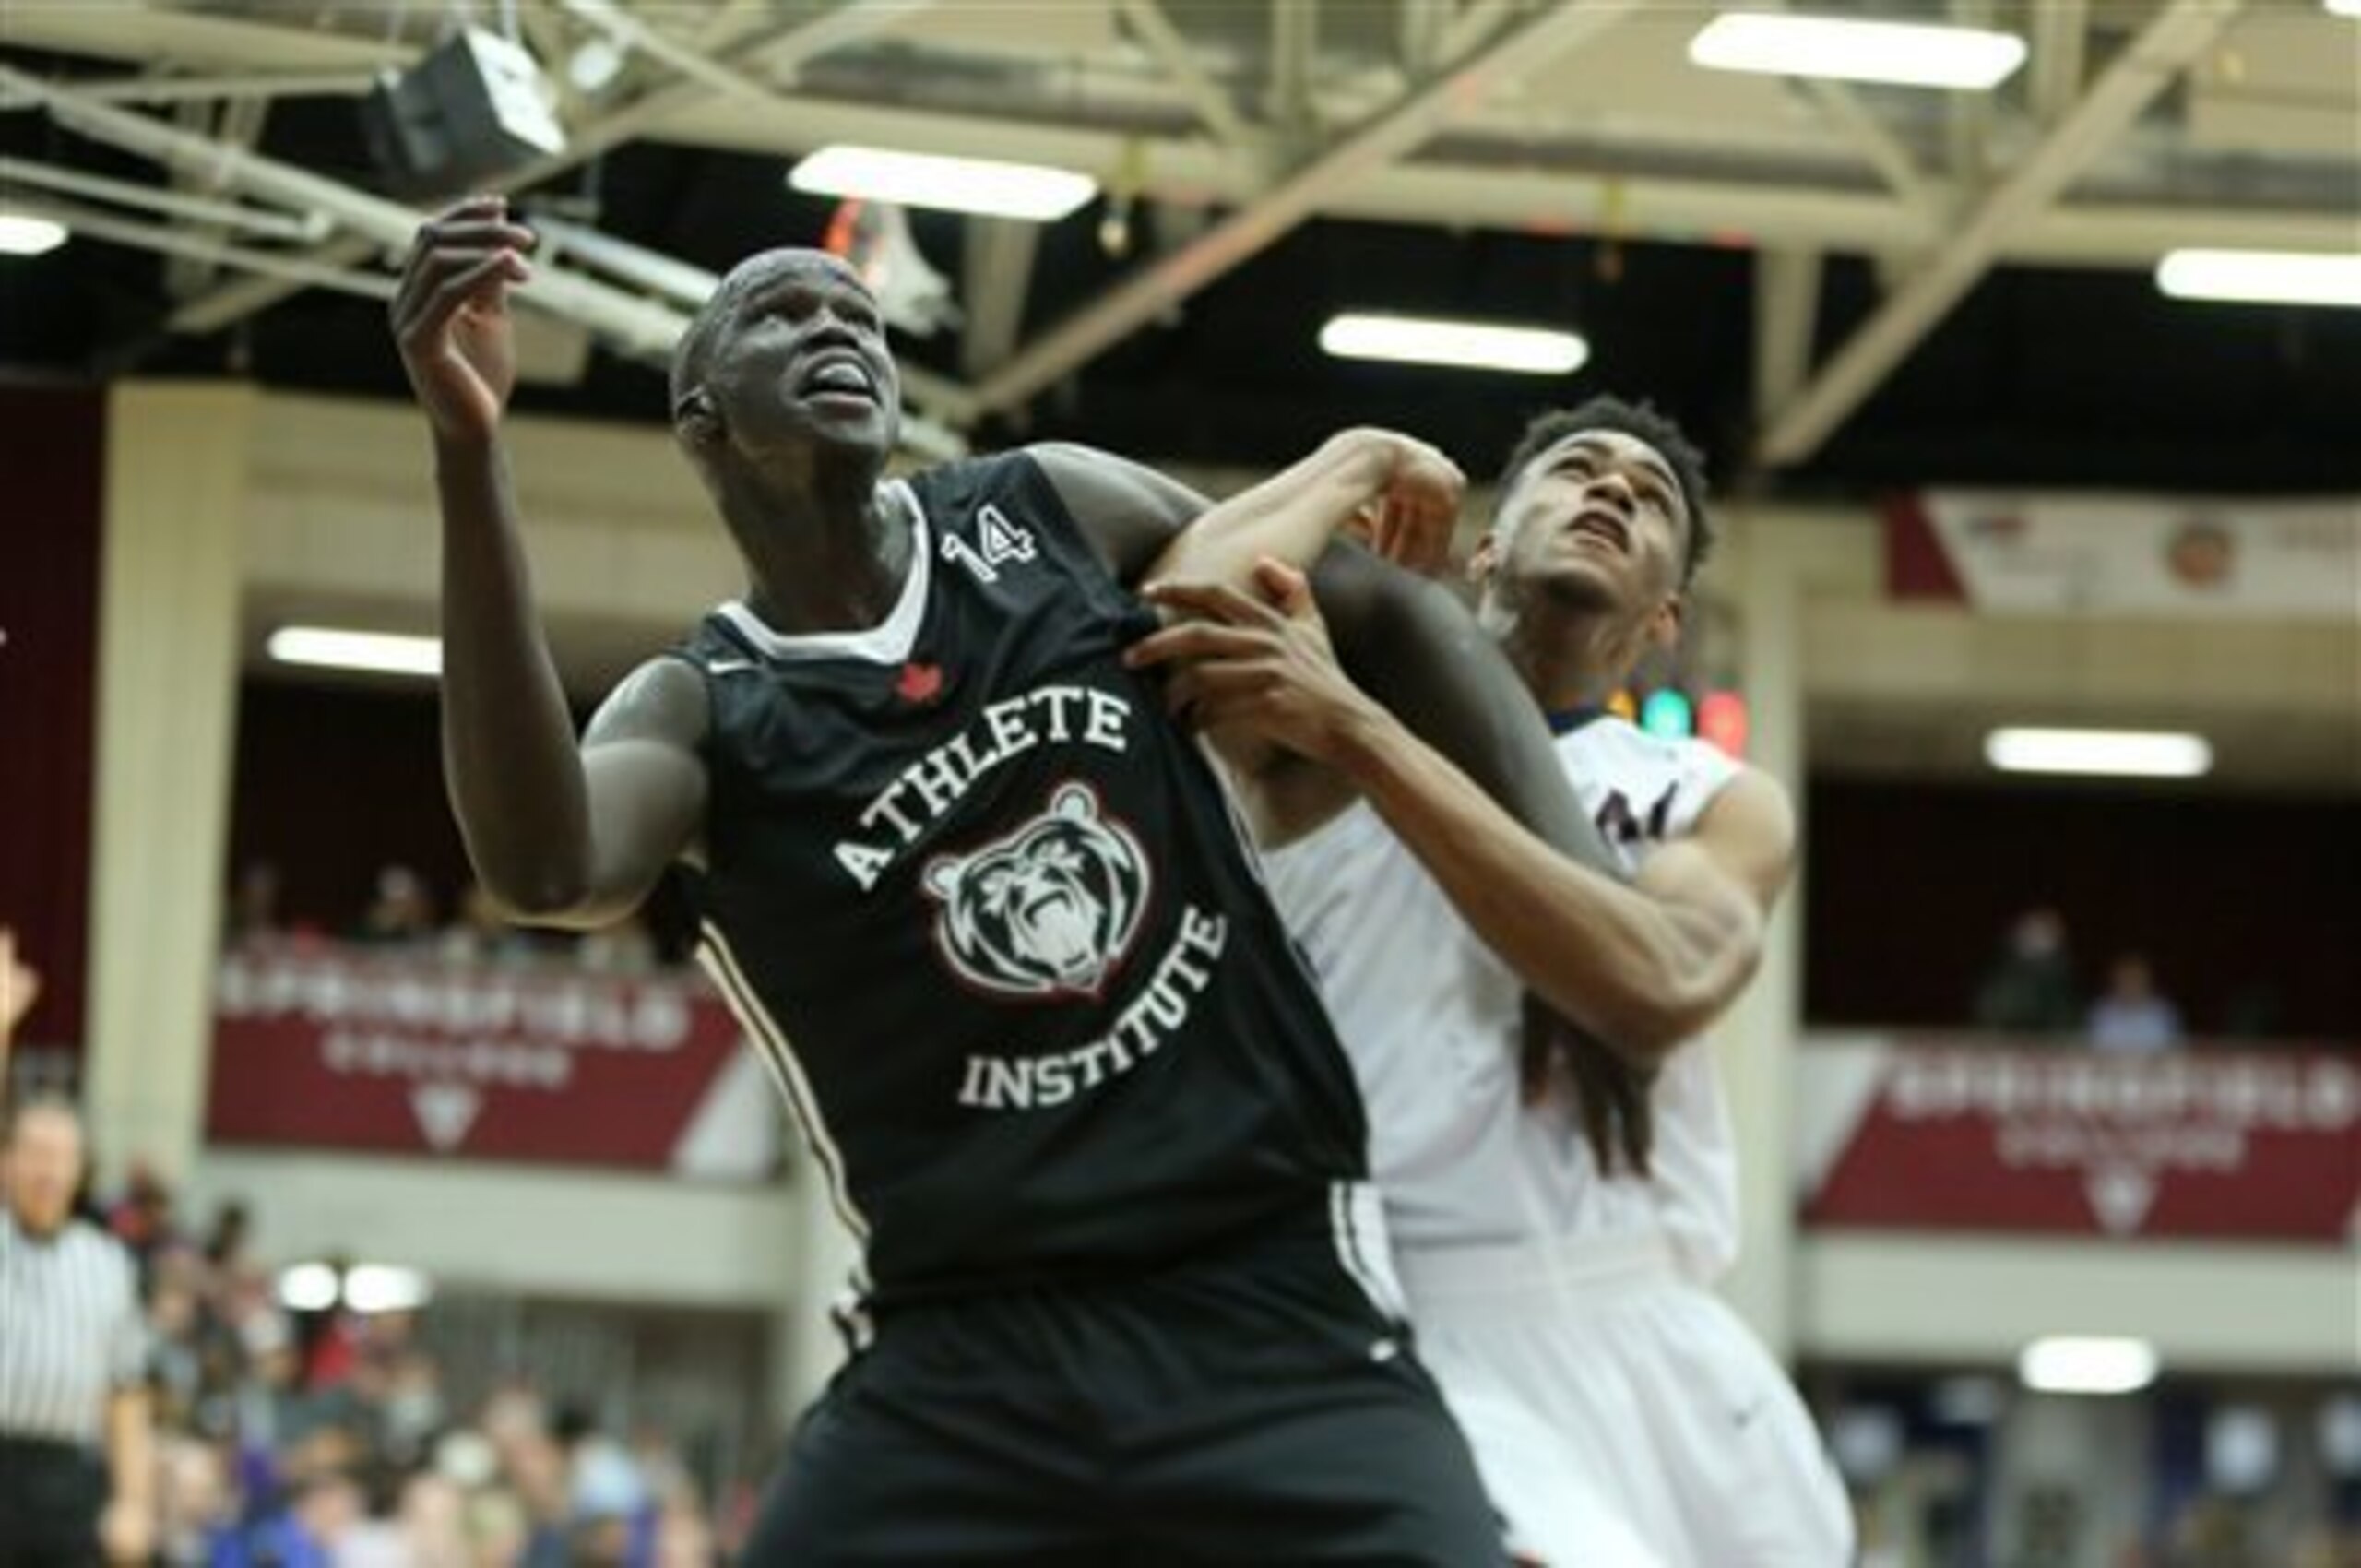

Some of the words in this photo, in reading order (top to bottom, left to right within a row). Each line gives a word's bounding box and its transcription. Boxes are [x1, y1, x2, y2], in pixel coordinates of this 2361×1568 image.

[940, 504, 1037, 582] 14
[834, 685, 1132, 892] ATHLETE
[958, 903, 1228, 1109] INSTITUTE
